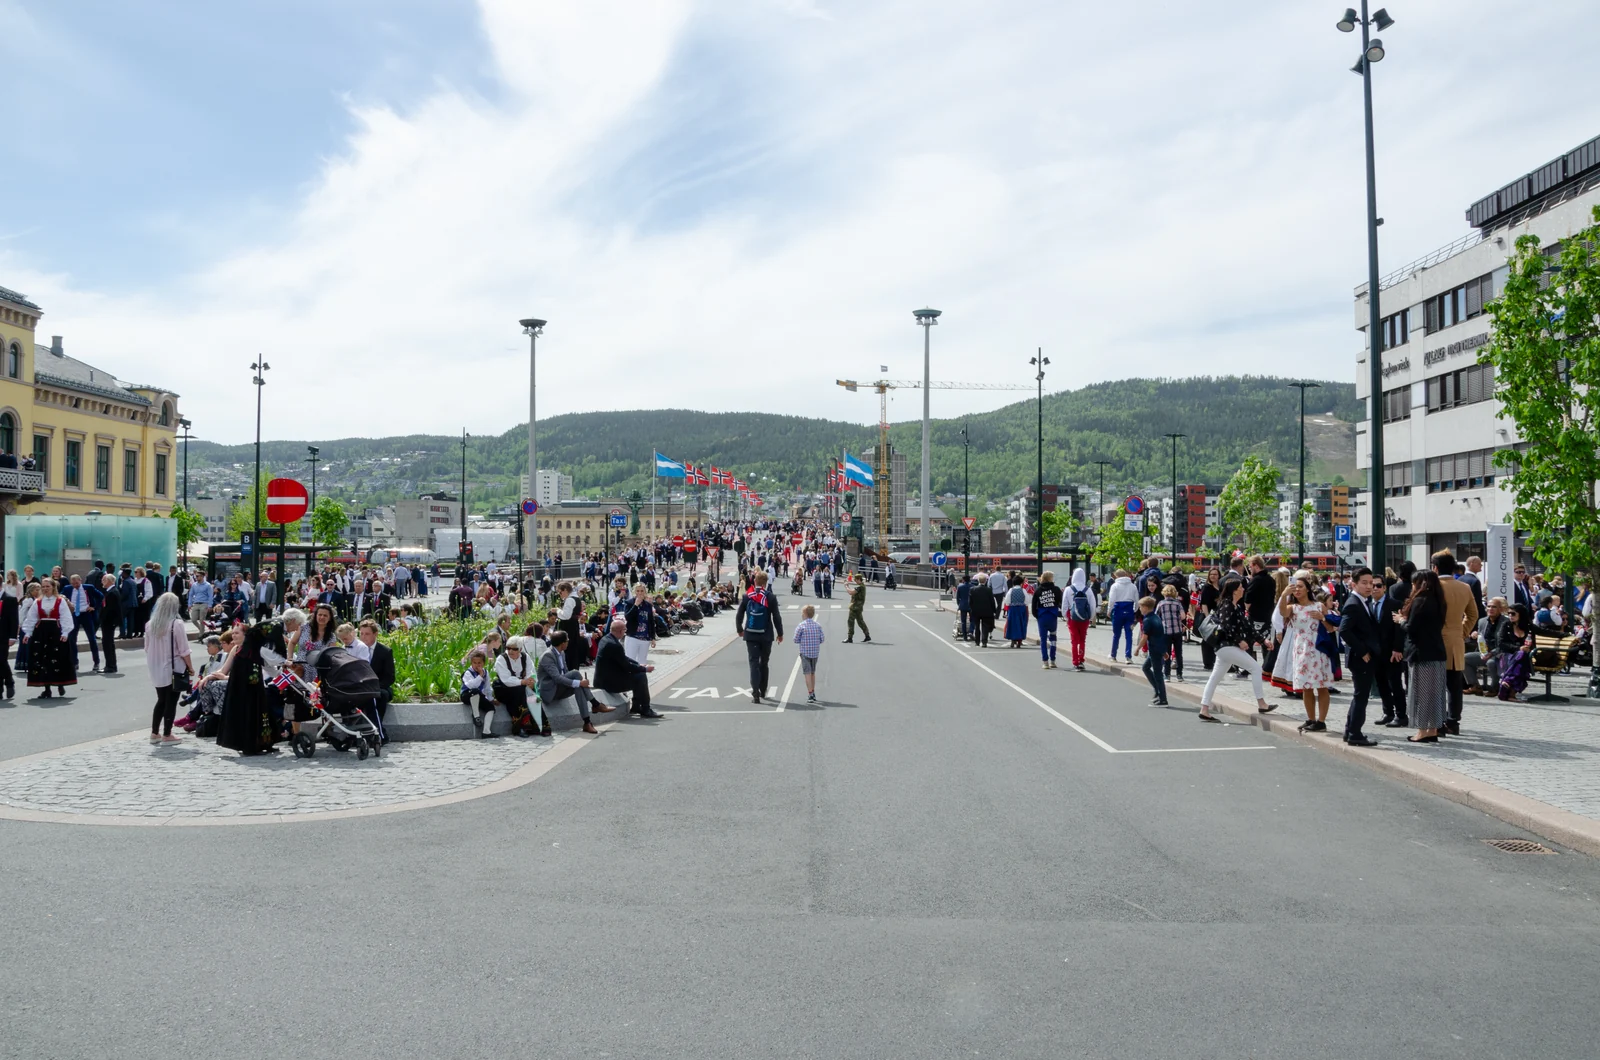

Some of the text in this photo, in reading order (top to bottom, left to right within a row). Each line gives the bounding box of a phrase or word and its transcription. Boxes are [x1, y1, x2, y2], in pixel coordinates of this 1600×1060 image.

[243, 535, 250, 544] B
[1338, 527, 1347, 540] P
[1499, 536, 1508, 595] Clear Channel
[668, 686, 778, 699] TAXI
